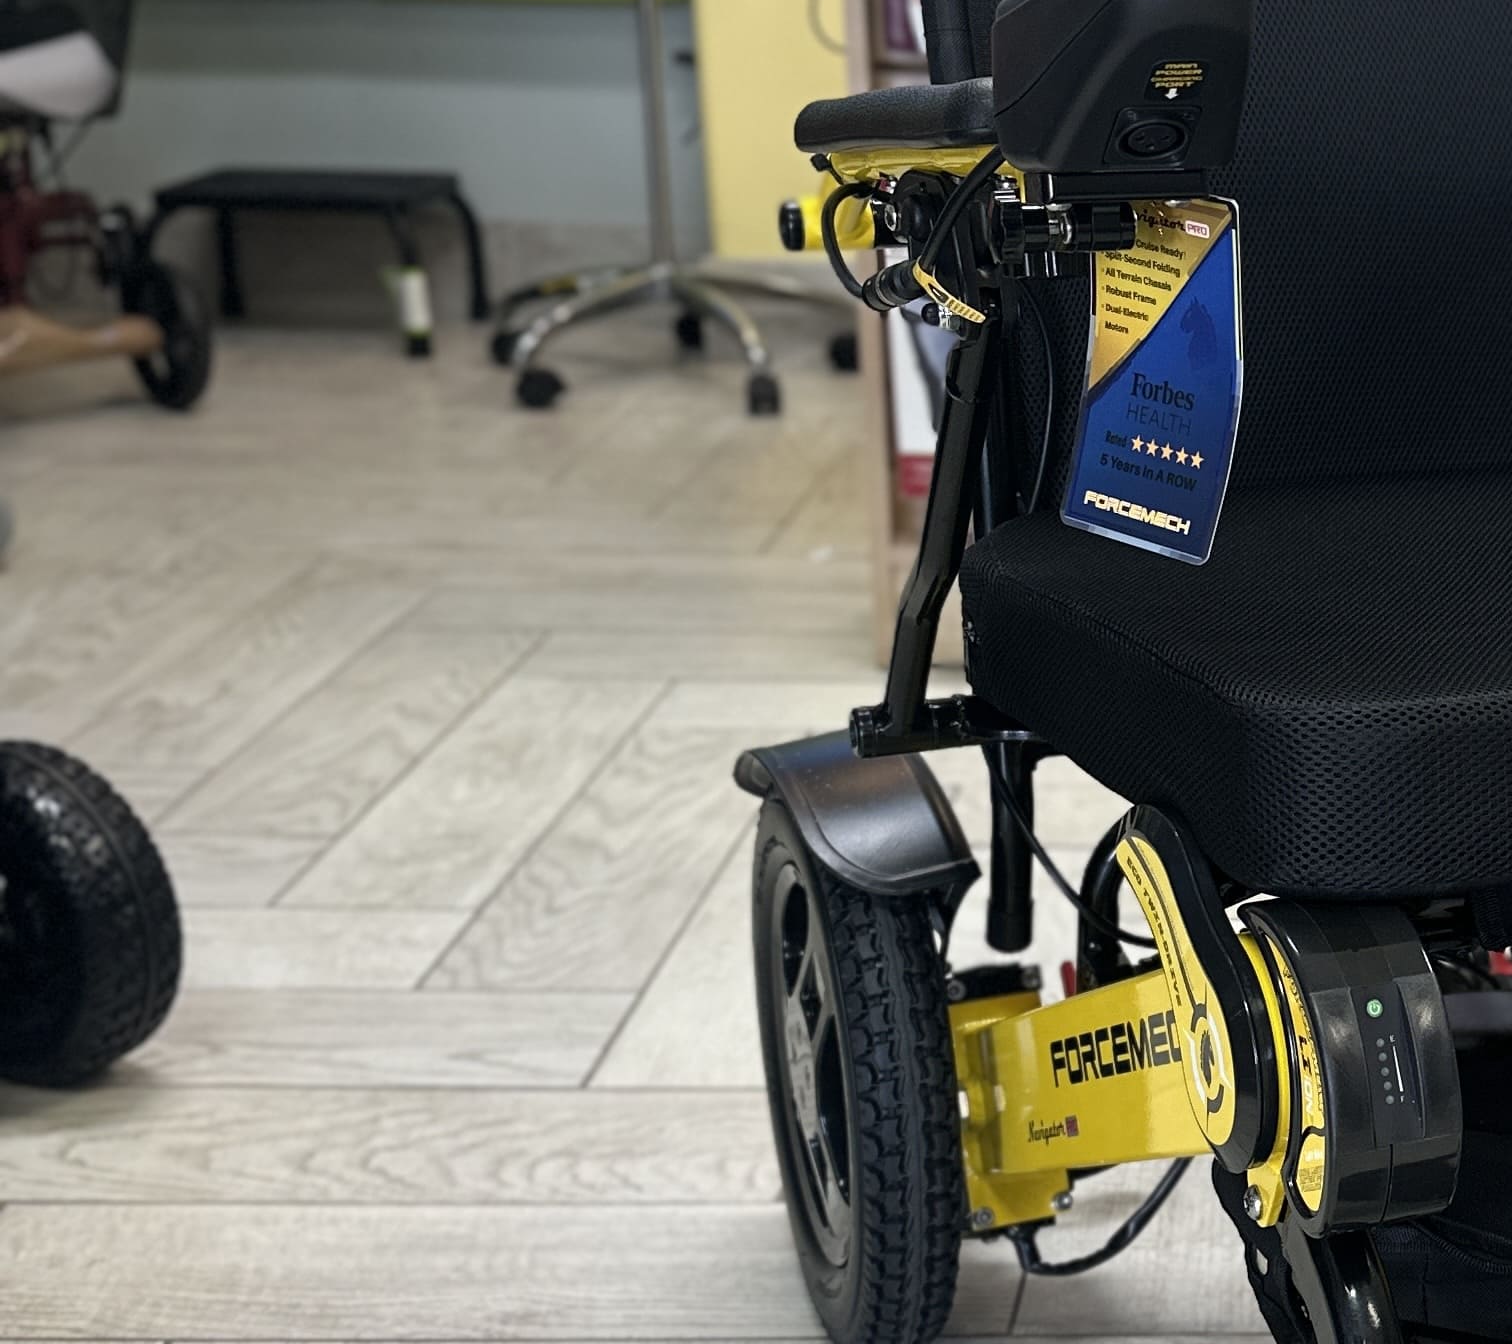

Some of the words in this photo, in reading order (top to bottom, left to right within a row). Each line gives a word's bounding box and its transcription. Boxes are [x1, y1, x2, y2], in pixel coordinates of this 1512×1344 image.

[1187, 224, 1208, 236] PRO
[1136, 239, 1159, 253] Cruise
[1160, 244, 1186, 261] Ready
[1105, 267, 1116, 277] All
[1116, 269, 1143, 284] Terrain
[1143, 276, 1172, 291] Chassis
[1152, 260, 1181, 278] Folding
[1105, 285, 1132, 299] Robust
[1133, 292, 1157, 305] Frame
[1105, 303, 1149, 321] Dual-Electric
[1105, 321, 1129, 334] Motors
[1130, 372, 1196, 411] Forbes
[1126, 402, 1192, 436] HEALTH
[1105, 430, 1127, 448] Rated
[1100, 453, 1109, 467] 5
[1111, 454, 1141, 476] Years
[1155, 469, 1164, 483] A
[1166, 472, 1198, 491] ROW
[1083, 490, 1191, 535] FORCEMECH
[1050, 1009, 1183, 1089] FORCEMEC
[1028, 1116, 1066, 1146] Navigator
